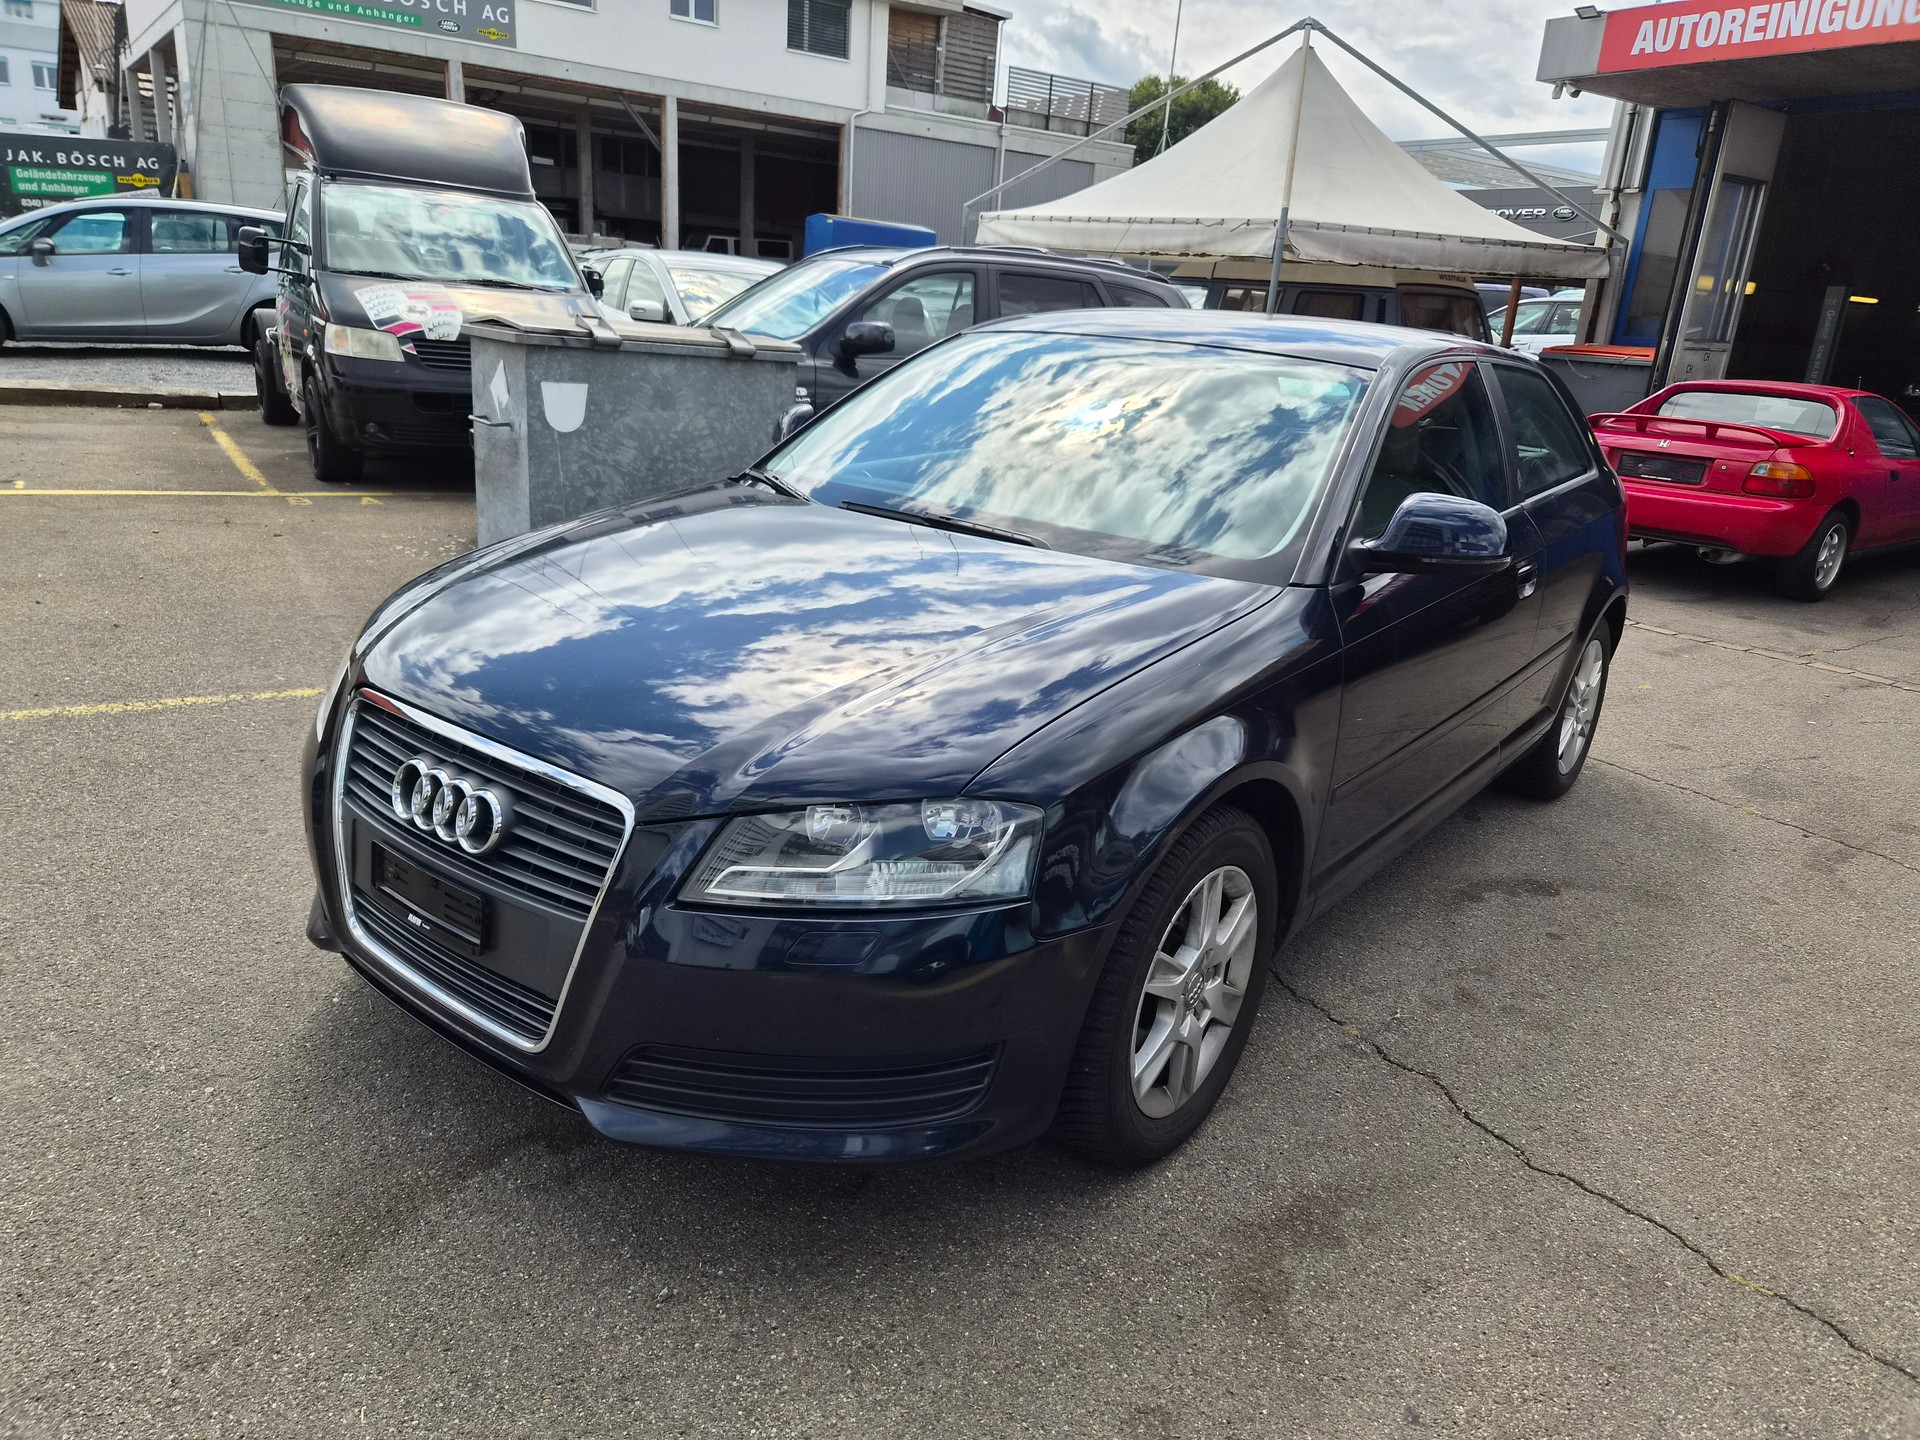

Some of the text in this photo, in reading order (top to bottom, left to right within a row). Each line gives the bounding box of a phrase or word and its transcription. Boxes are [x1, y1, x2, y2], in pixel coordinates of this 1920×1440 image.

[328, 3, 350, 12] und
[357, 7, 415, 23] Anhänger
[481, 4, 509, 23] AG
[6, 149, 160, 170] JAK. BÖSCH AG
[16, 169, 107, 183] Geländefahrzeuge
[18, 182, 89, 194] und Anhänger
